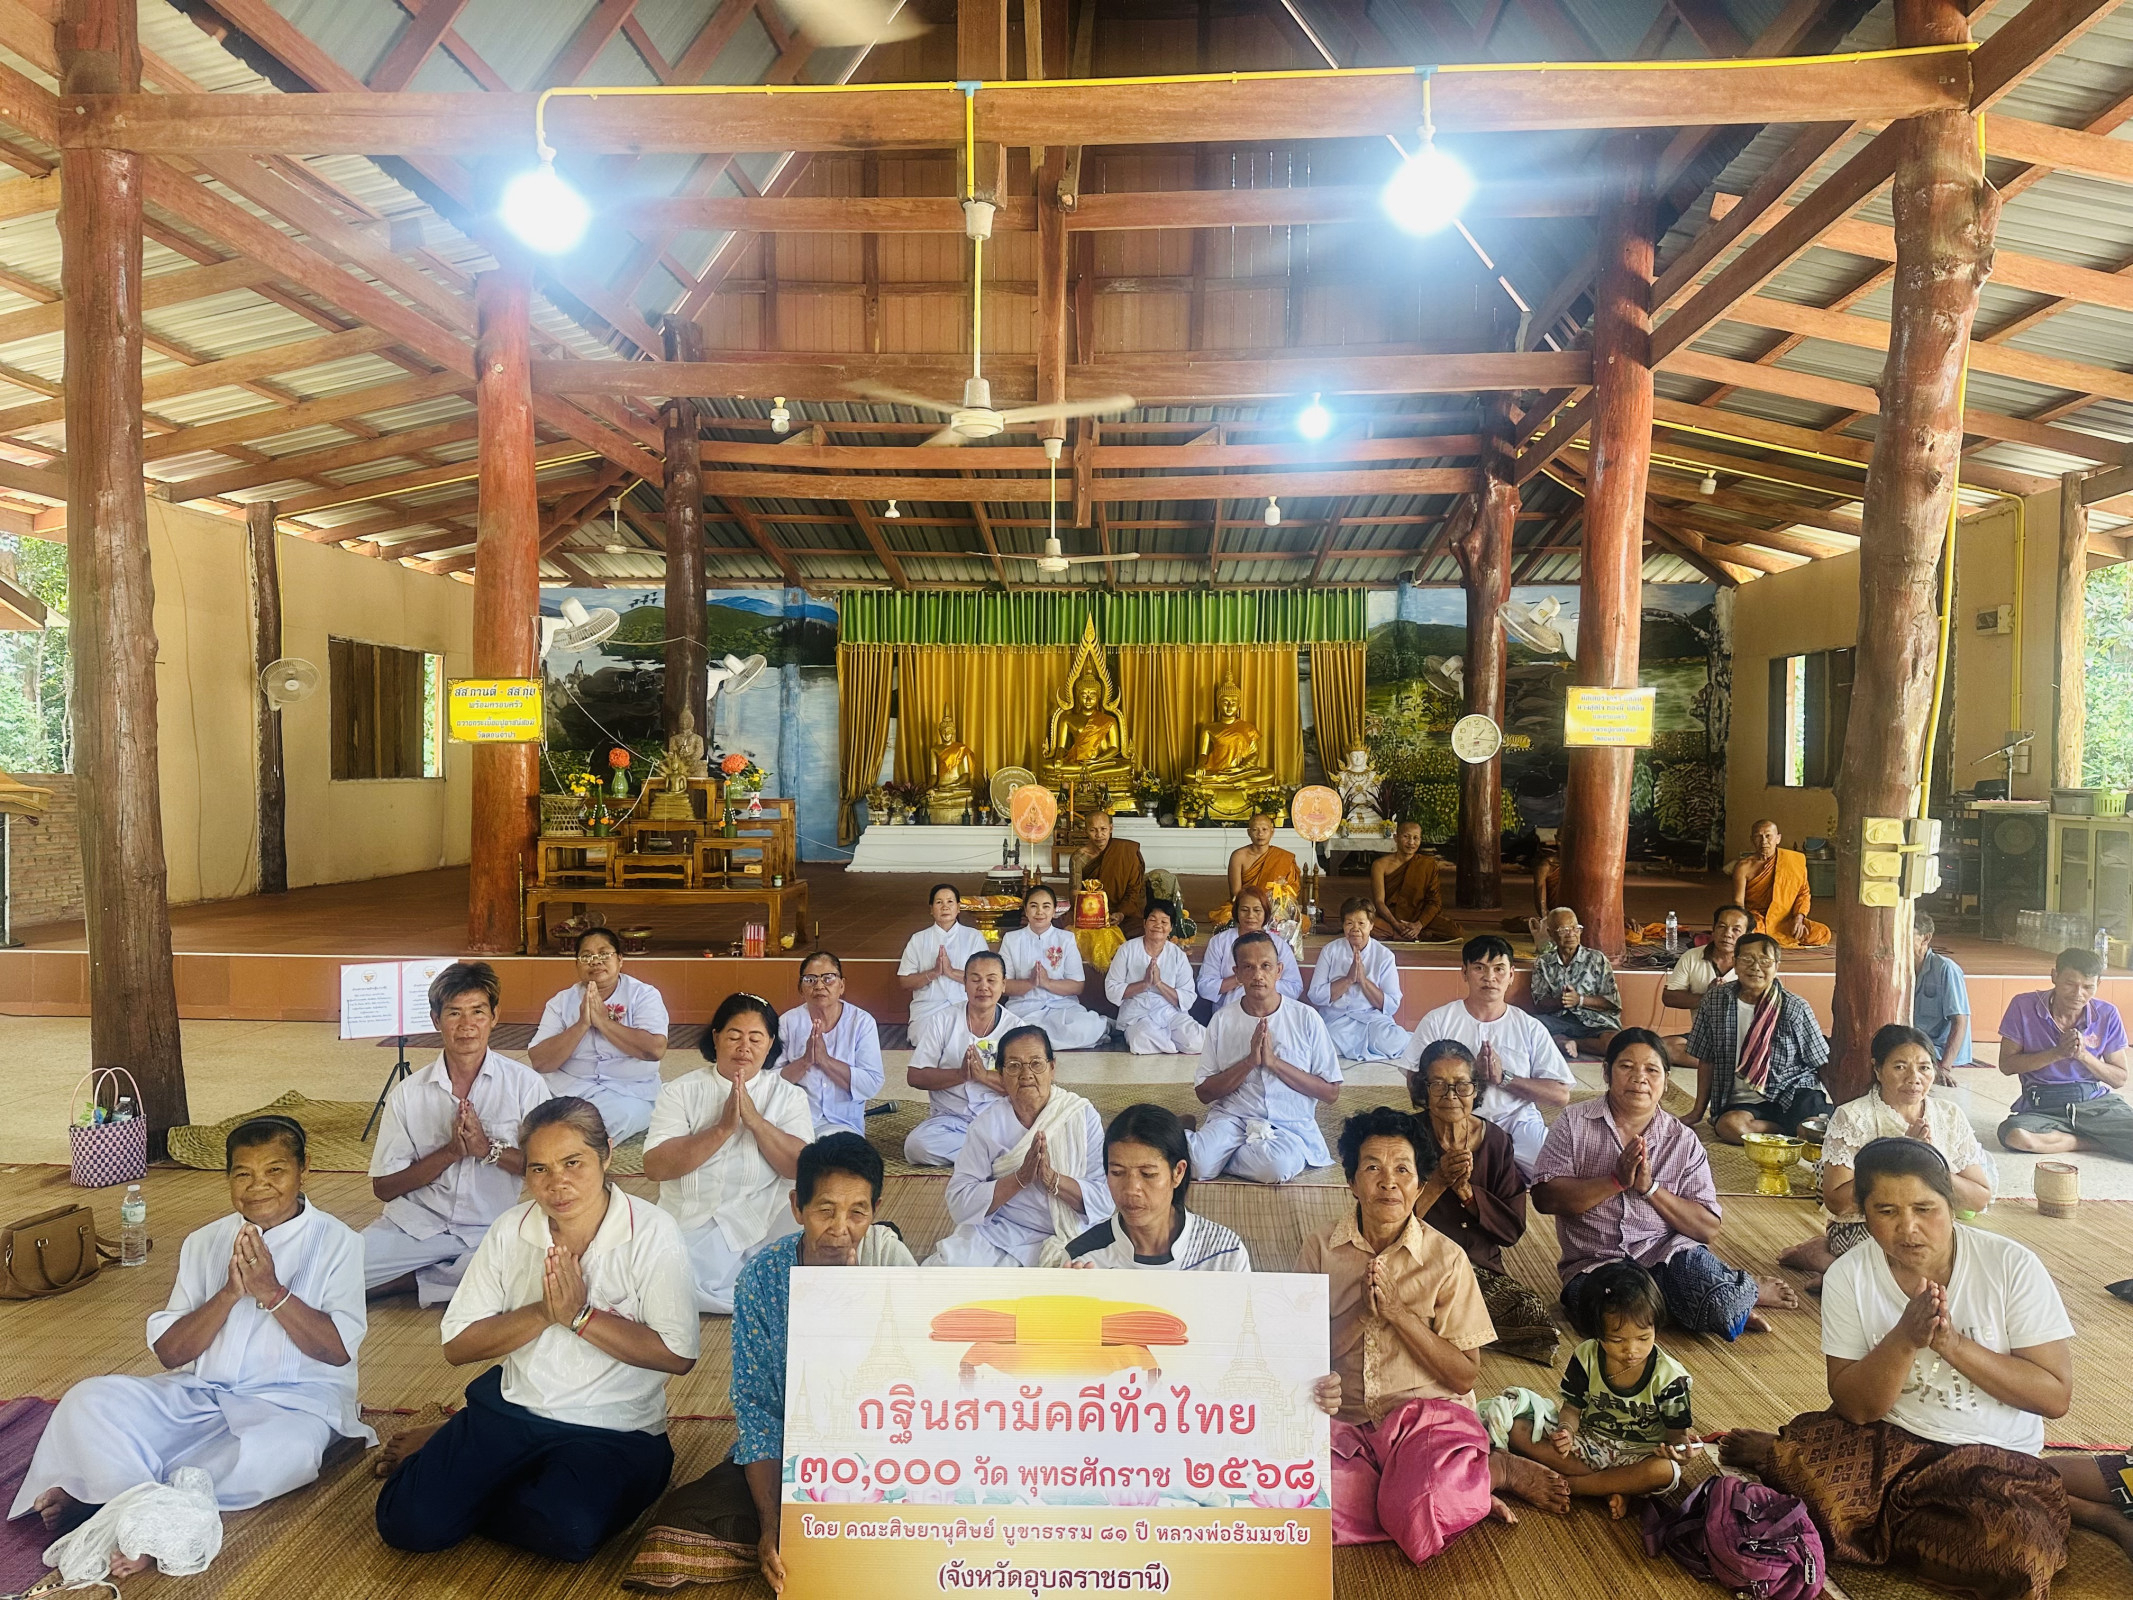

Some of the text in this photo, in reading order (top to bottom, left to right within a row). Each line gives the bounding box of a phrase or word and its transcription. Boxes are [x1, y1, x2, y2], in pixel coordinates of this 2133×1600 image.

[858, 1372, 1256, 1445] กฐินสามัคคีทั่วไทย
[799, 1455, 1315, 1497] ๓๐,๐๐๐ วัด พุทธศักราช ๒๕๖๘
[803, 1516, 1310, 1546] โดย คณะศิษยานุศิษย์ บูชาธรรม ๘๑ ปี หลวงพ่อธัมมชโย
[938, 1559, 1170, 1598] (จังหวัดอุบลราชธานี)
